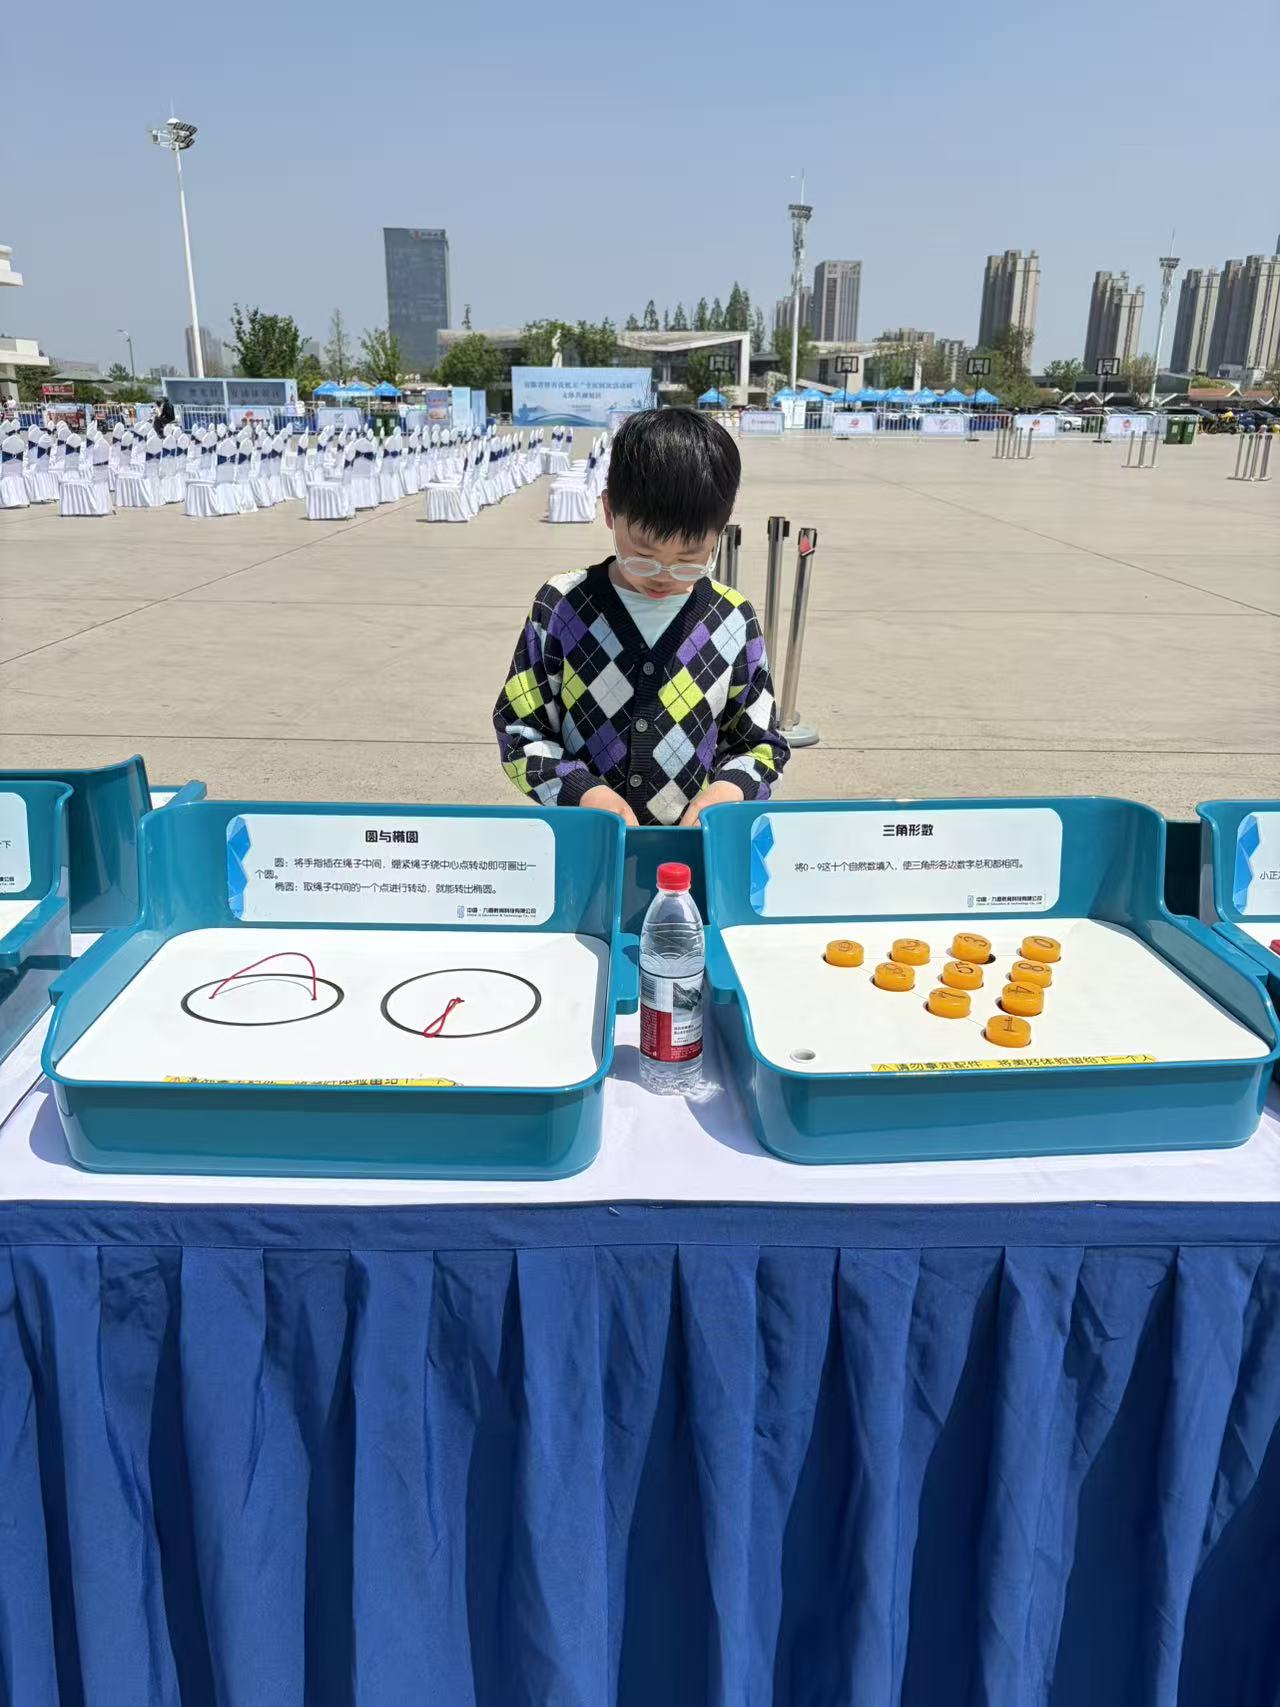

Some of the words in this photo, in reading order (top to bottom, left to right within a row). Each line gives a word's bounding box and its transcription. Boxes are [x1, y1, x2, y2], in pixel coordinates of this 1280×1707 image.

[365, 830, 419, 844] 圆与椭圆
[882, 824, 934, 837] 三角形数
[254, 869, 279, 880] 个圆。
[1259, 870, 1280, 880] 小正
[954, 961, 974, 974] 5
